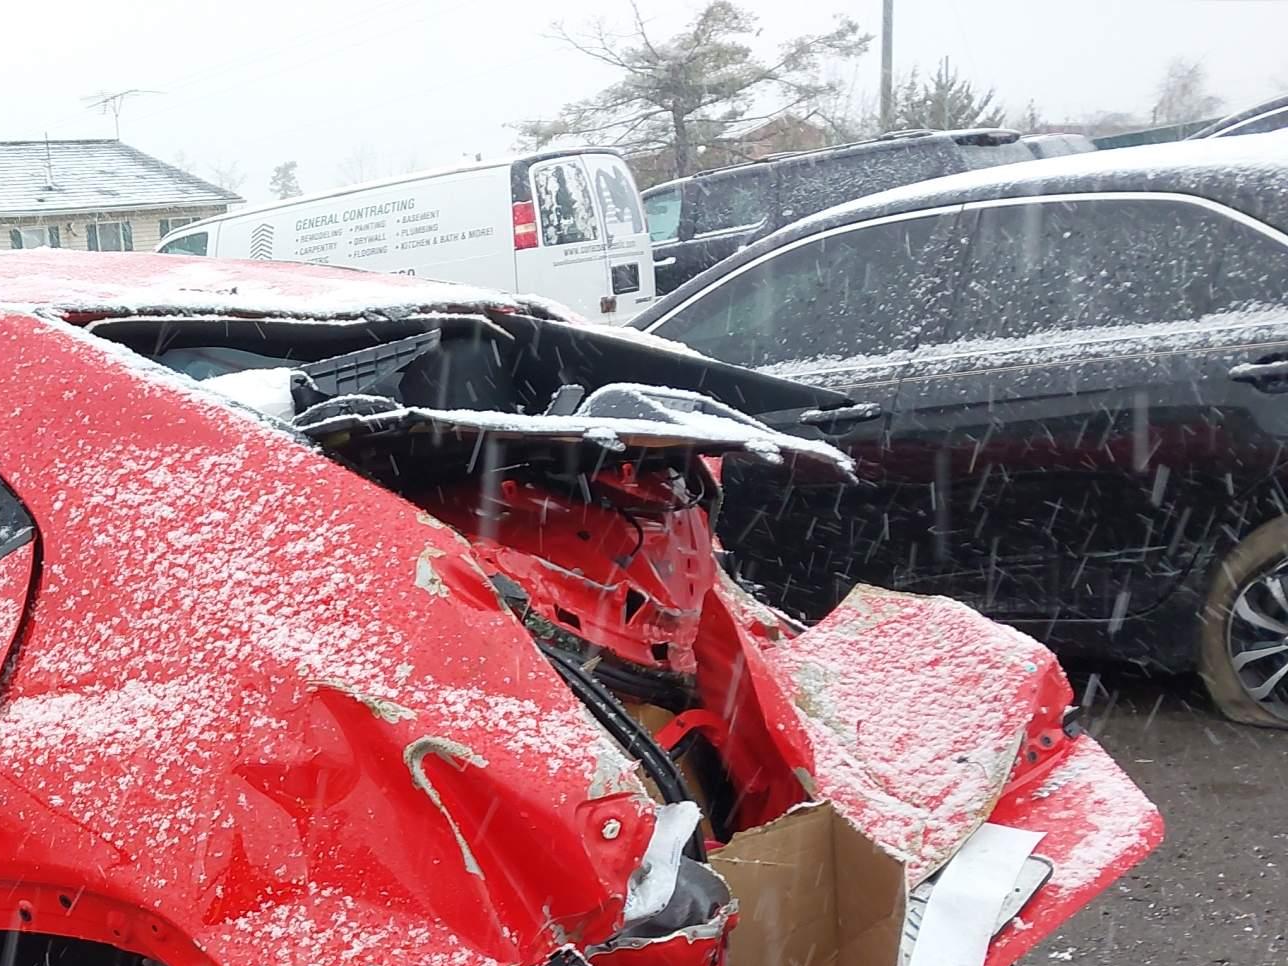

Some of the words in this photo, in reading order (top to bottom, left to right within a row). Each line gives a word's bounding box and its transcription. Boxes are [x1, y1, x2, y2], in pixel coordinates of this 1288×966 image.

[295, 213, 340, 231] GENERAL
[342, 198, 416, 222] CONTRACTING
[402, 209, 440, 224] BASEMENT
[354, 220, 387, 233] PAINTING
[401, 223, 439, 237] PLUMBING
[300, 228, 343, 243] REMODELING
[353, 232, 386, 246] DRYWALL
[400, 238, 431, 250] KITCHEN
[440, 233, 459, 244] BATH
[468, 226, 494, 239] MORE!
[299, 242, 337, 256] CARPENTRY
[353, 245, 388, 258] FLOORING
